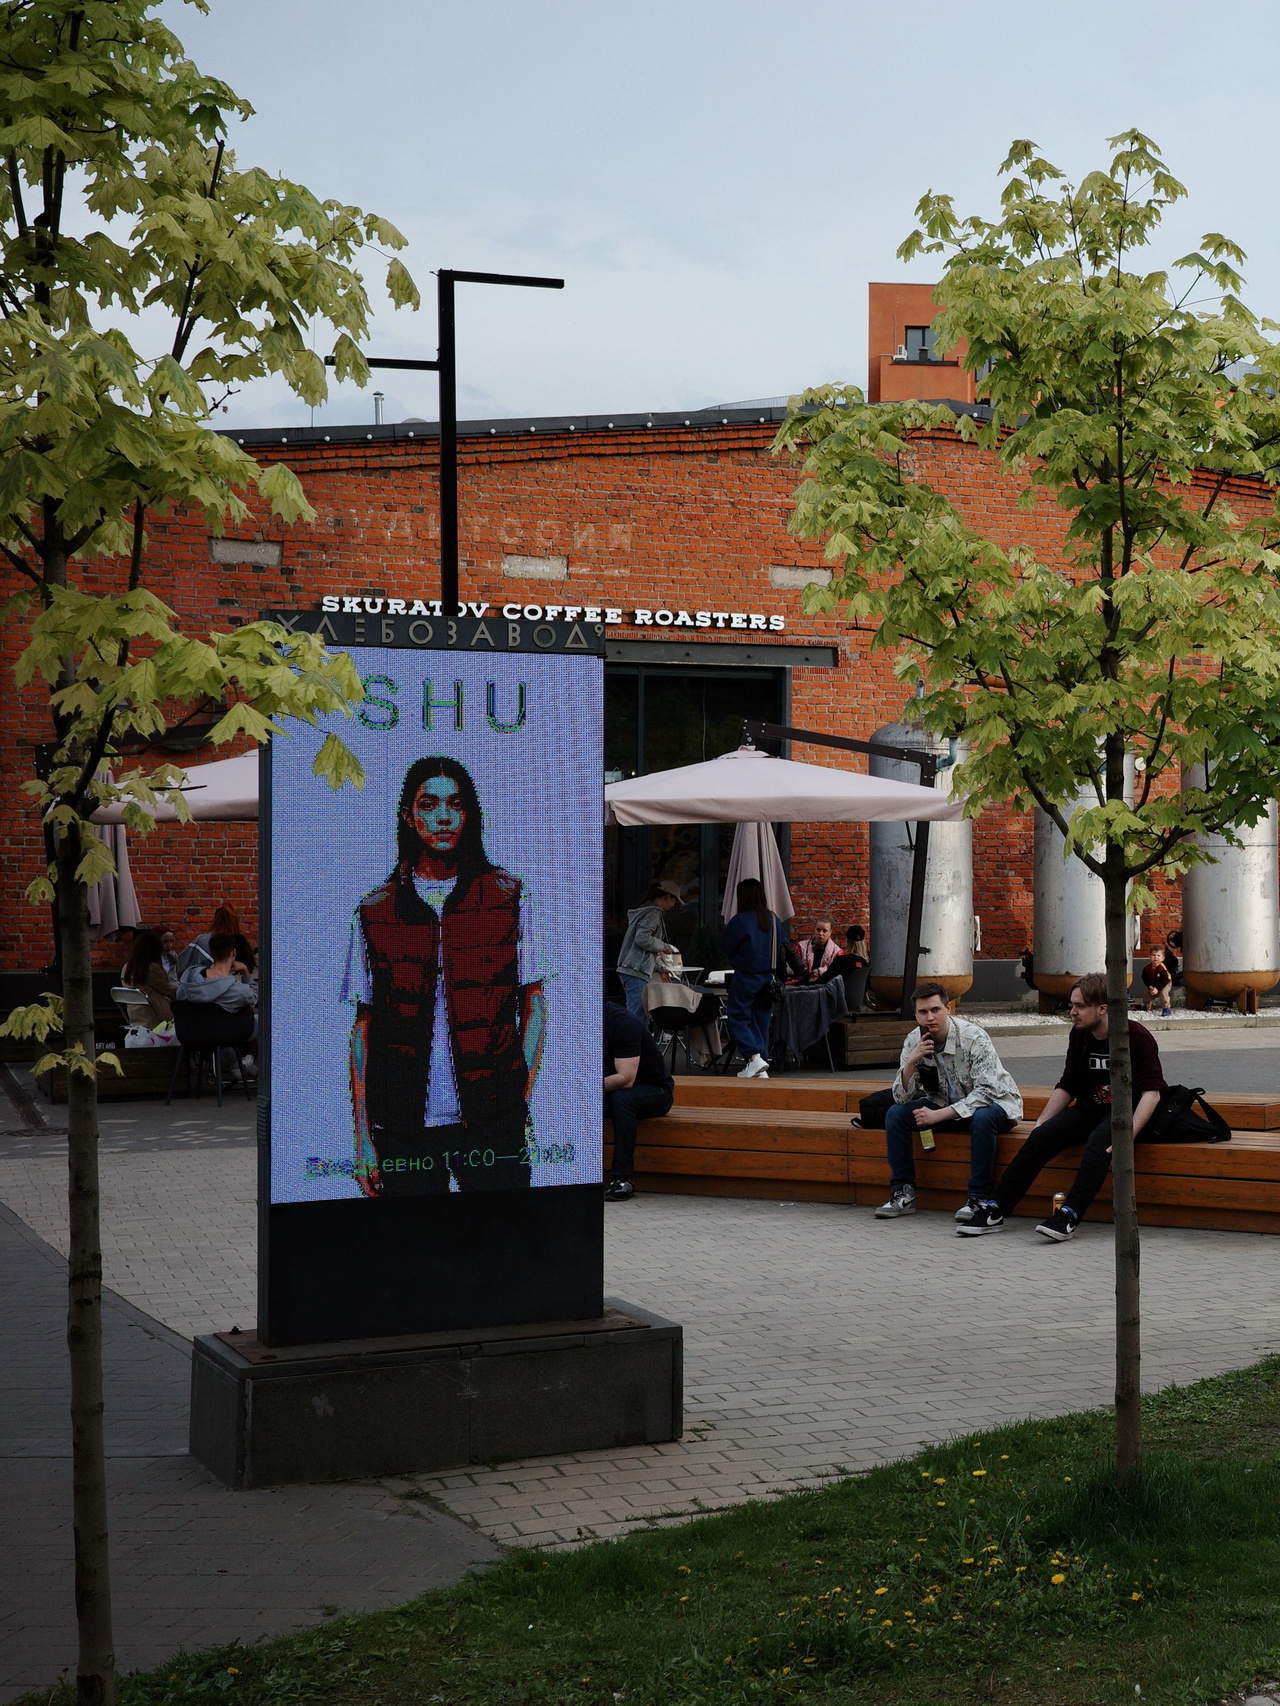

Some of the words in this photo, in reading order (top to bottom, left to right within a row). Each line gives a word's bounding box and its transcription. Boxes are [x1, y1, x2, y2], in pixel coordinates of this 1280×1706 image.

[502, 603, 622, 624] COFFEE
[634, 609, 785, 631] ROASTERS
[358, 674, 527, 733] SHU
